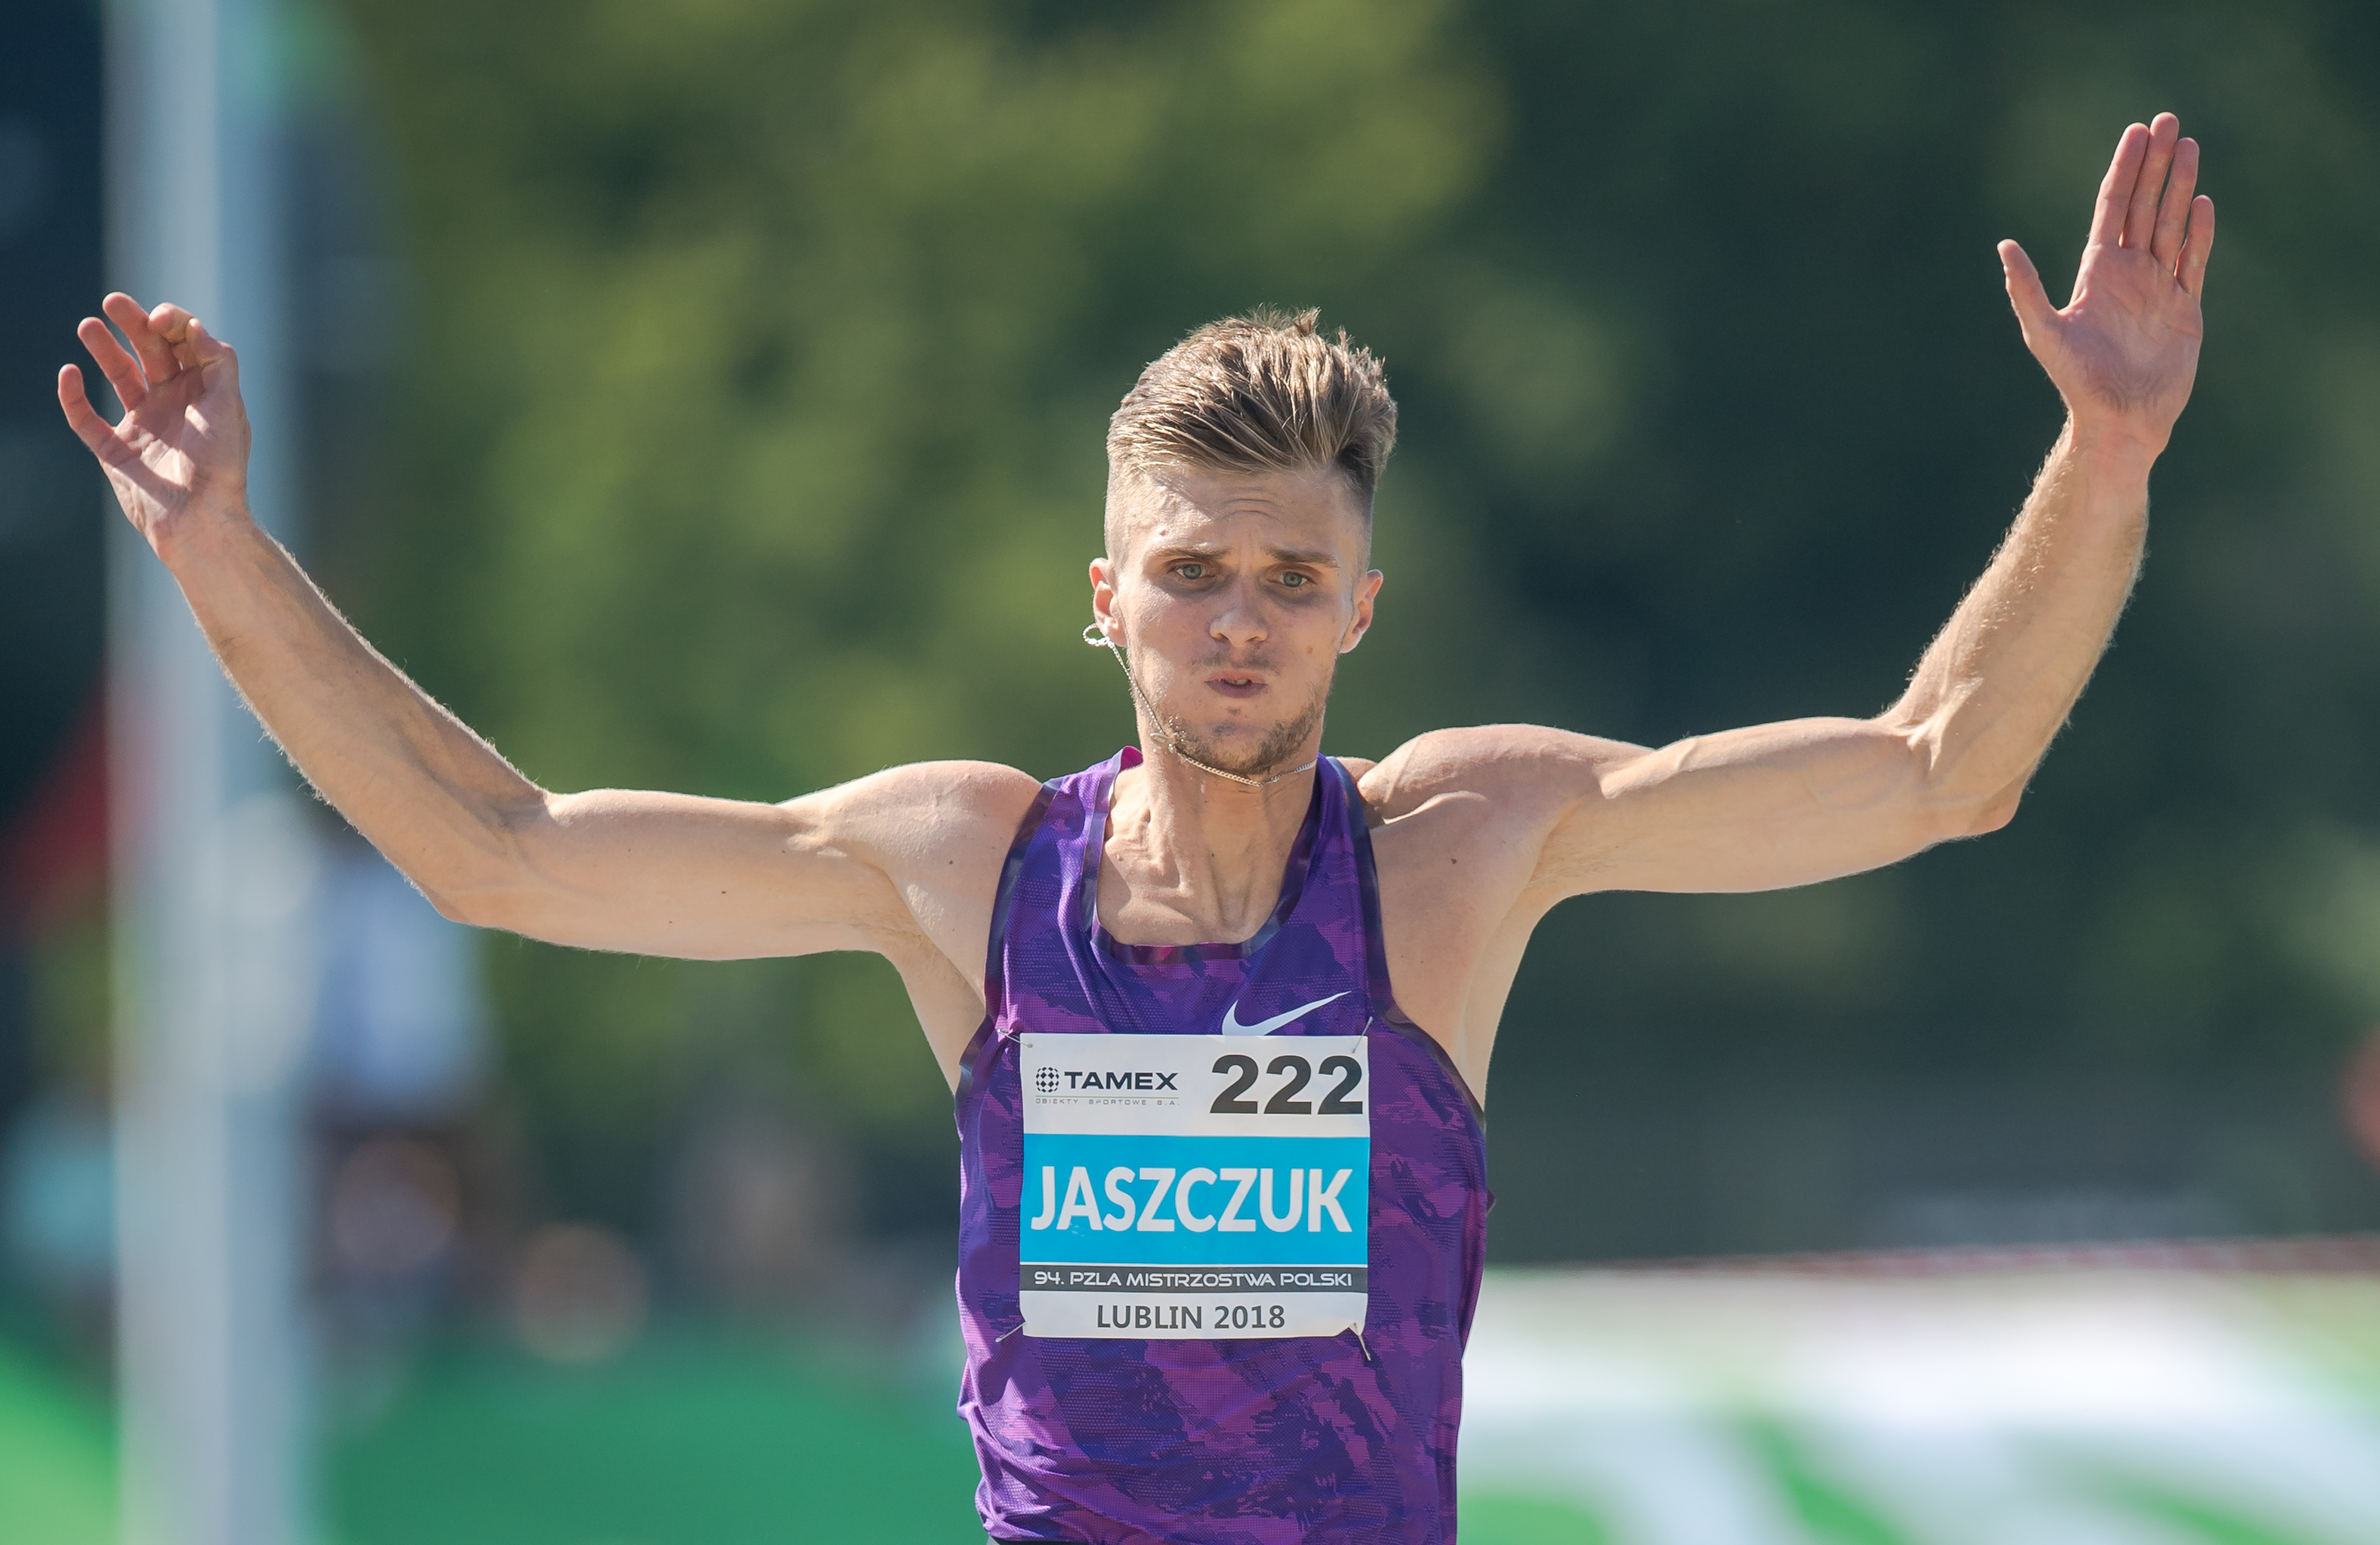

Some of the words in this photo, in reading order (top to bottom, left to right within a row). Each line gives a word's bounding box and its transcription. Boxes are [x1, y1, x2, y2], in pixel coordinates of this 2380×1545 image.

[1064, 1071, 1179, 1091] TAMEX
[1209, 1054, 1364, 1115] 222
[1030, 1165, 1353, 1233] JASZCZUK
[1034, 1270, 1065, 1285] 94.
[1070, 1272, 1123, 1287] PZLA
[1126, 1272, 1276, 1287] MISTRZOSTWA
[1280, 1273, 1352, 1287] POLSKI
[1097, 1304, 1203, 1329] LUBLIN
[1213, 1305, 1286, 1329] 2018
